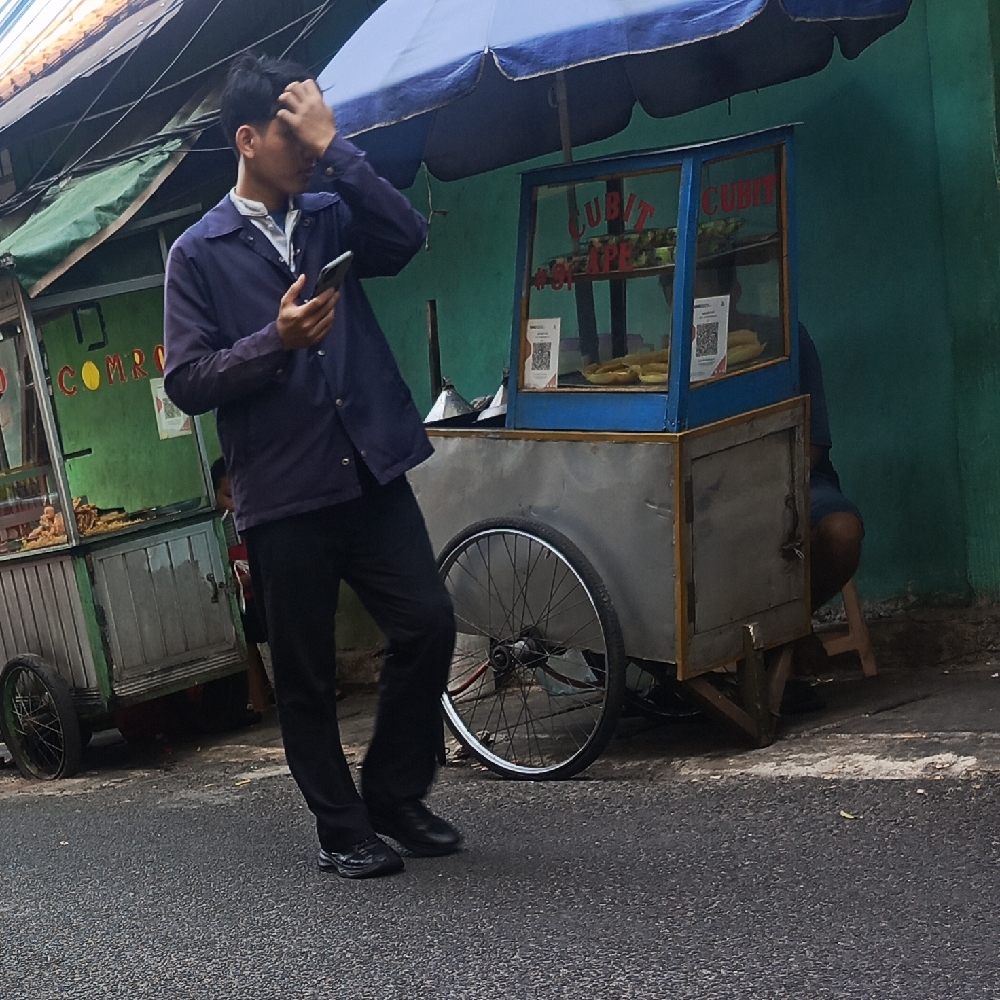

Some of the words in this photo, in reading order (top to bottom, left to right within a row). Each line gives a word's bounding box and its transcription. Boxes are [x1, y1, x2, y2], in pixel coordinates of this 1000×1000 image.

[568, 191, 656, 240] CUBIT
[701, 174, 777, 216] CUBIT
[586, 241, 635, 274] APE
[57, 344, 165, 397] COMRO
